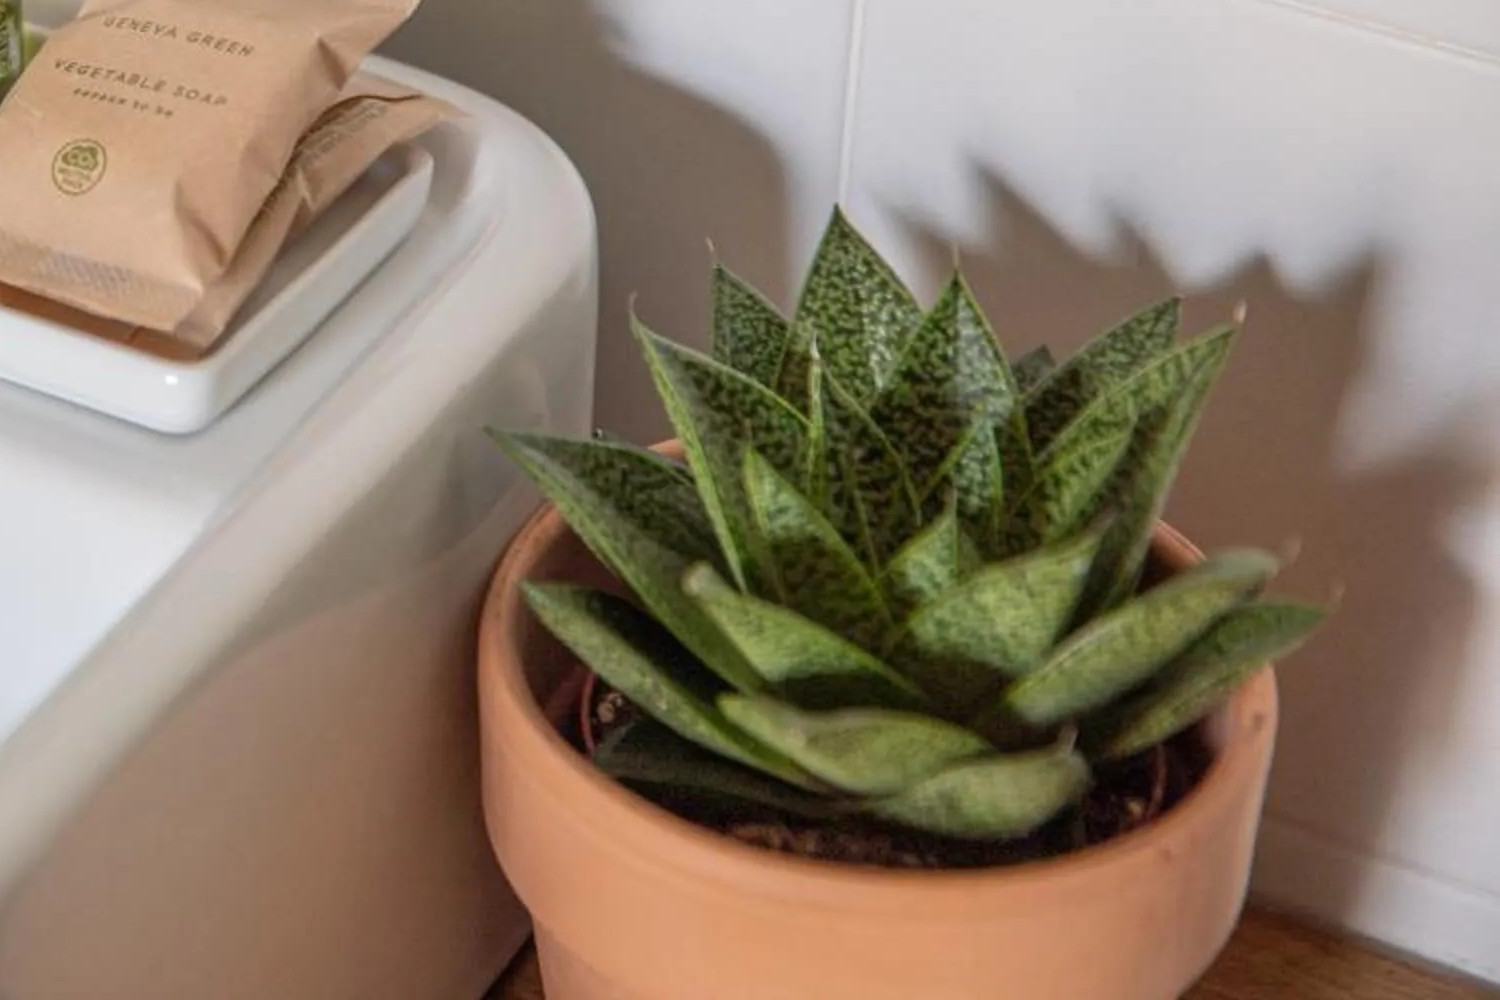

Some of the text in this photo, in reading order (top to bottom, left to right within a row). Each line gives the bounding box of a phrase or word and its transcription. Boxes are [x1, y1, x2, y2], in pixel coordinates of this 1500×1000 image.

[103, 14, 254, 57] GENEVA GREEN
[54, 58, 228, 106] VEGETABLE SOAP
